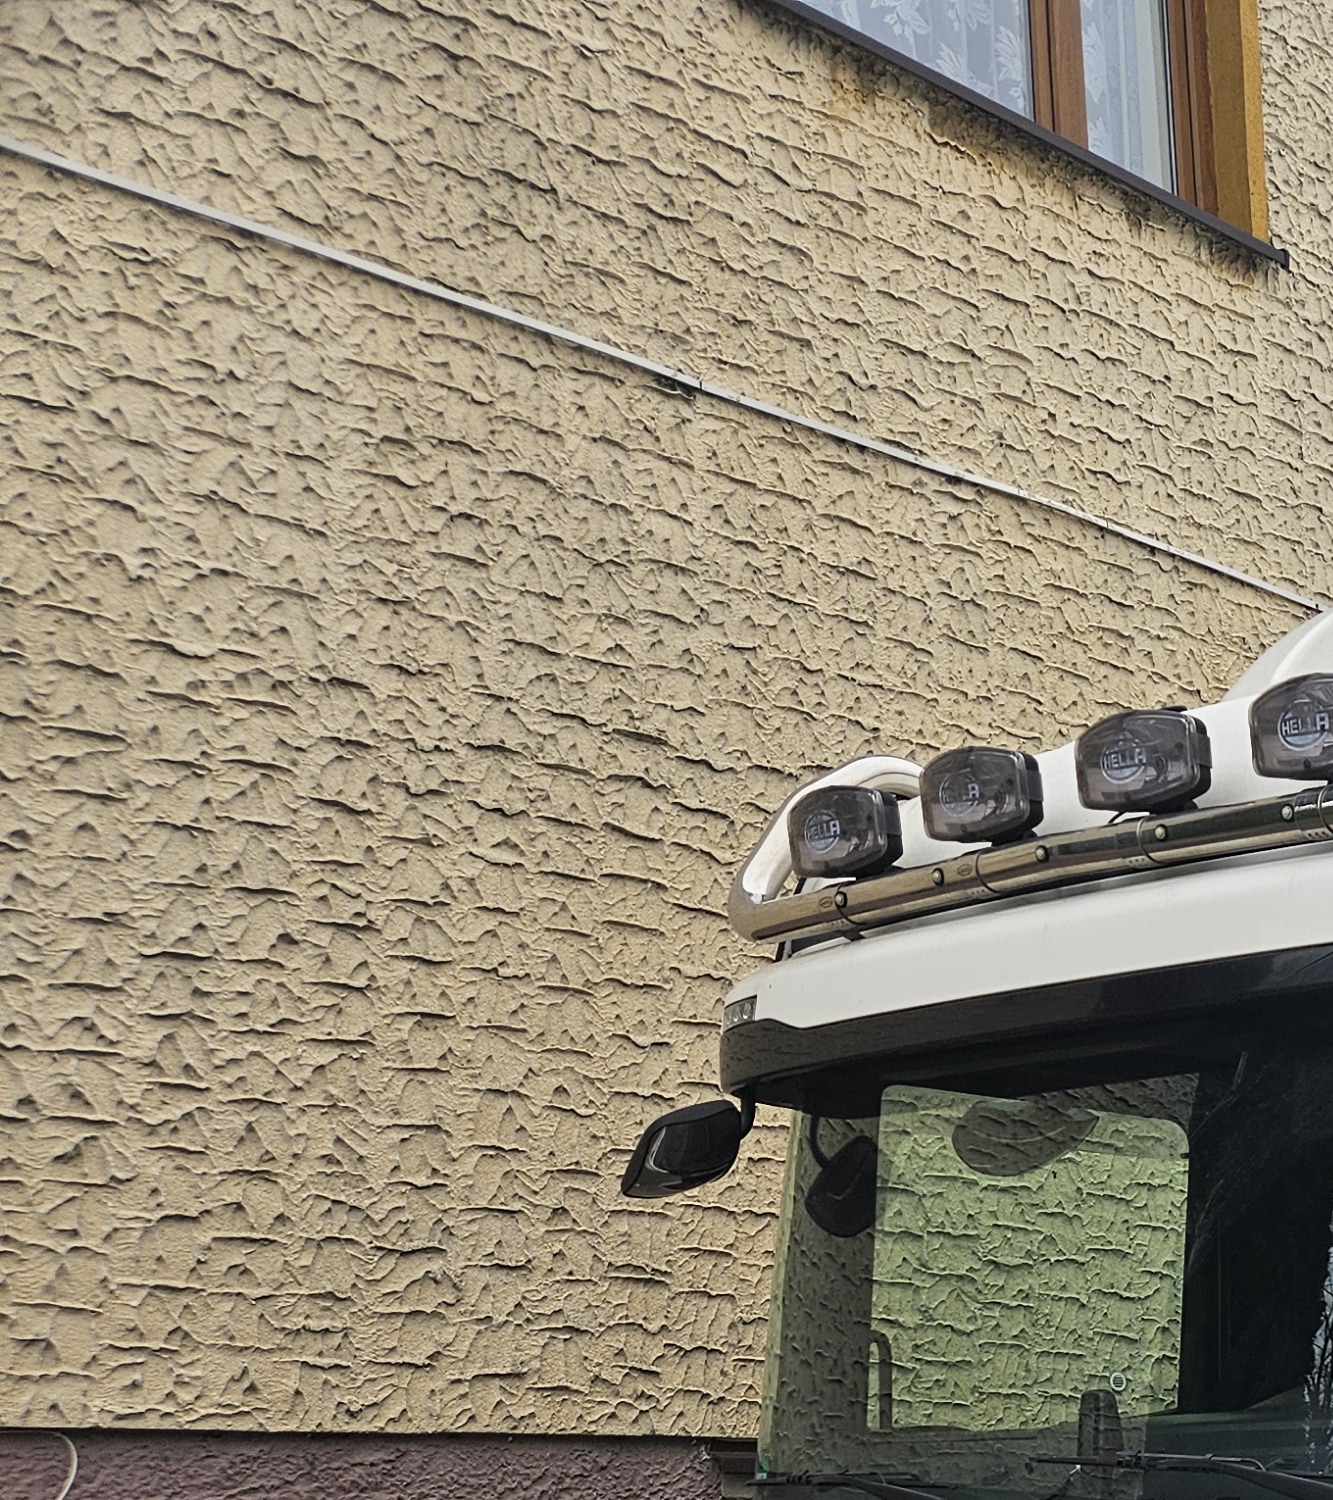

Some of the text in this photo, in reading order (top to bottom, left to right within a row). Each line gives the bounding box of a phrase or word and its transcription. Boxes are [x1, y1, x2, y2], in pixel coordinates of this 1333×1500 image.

[1281, 712, 1330, 736] HELLA
[1102, 747, 1147, 771] HELLA
[807, 819, 841, 841] HELLA
